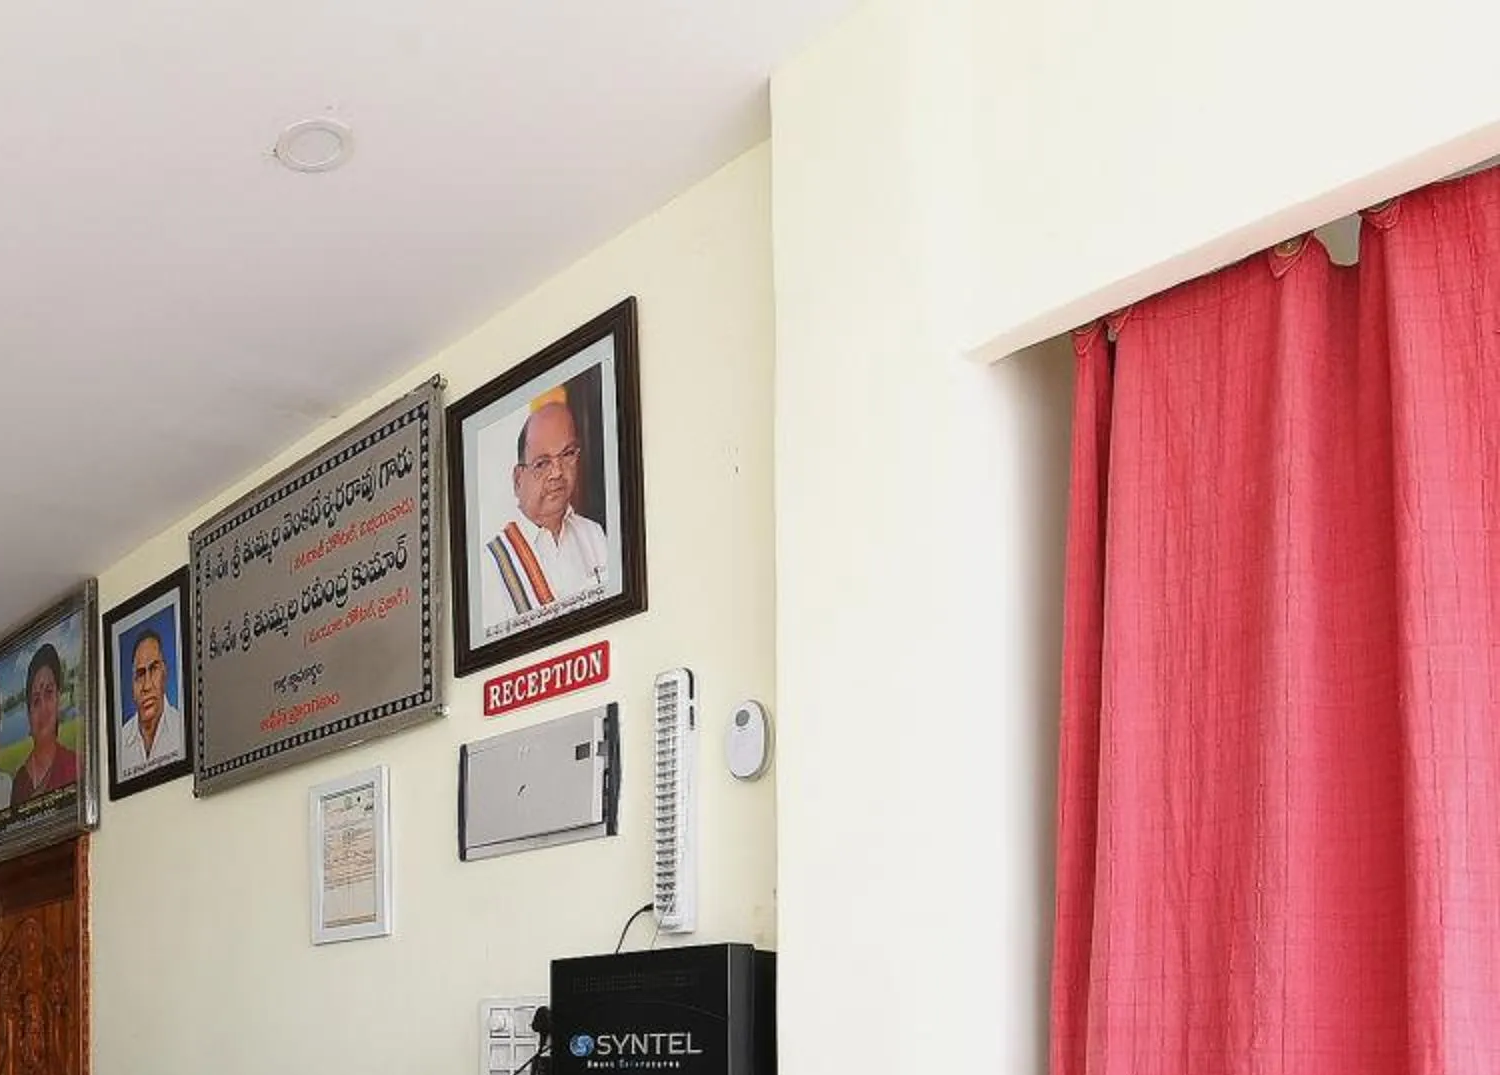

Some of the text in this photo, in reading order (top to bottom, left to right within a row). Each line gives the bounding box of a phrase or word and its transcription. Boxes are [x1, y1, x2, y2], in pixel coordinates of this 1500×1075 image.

[378, 446, 414, 489] గారు
[351, 534, 409, 592] కుమార్
[488, 649, 604, 710] RECEPTION
[596, 1031, 704, 1056] SYNTEL
